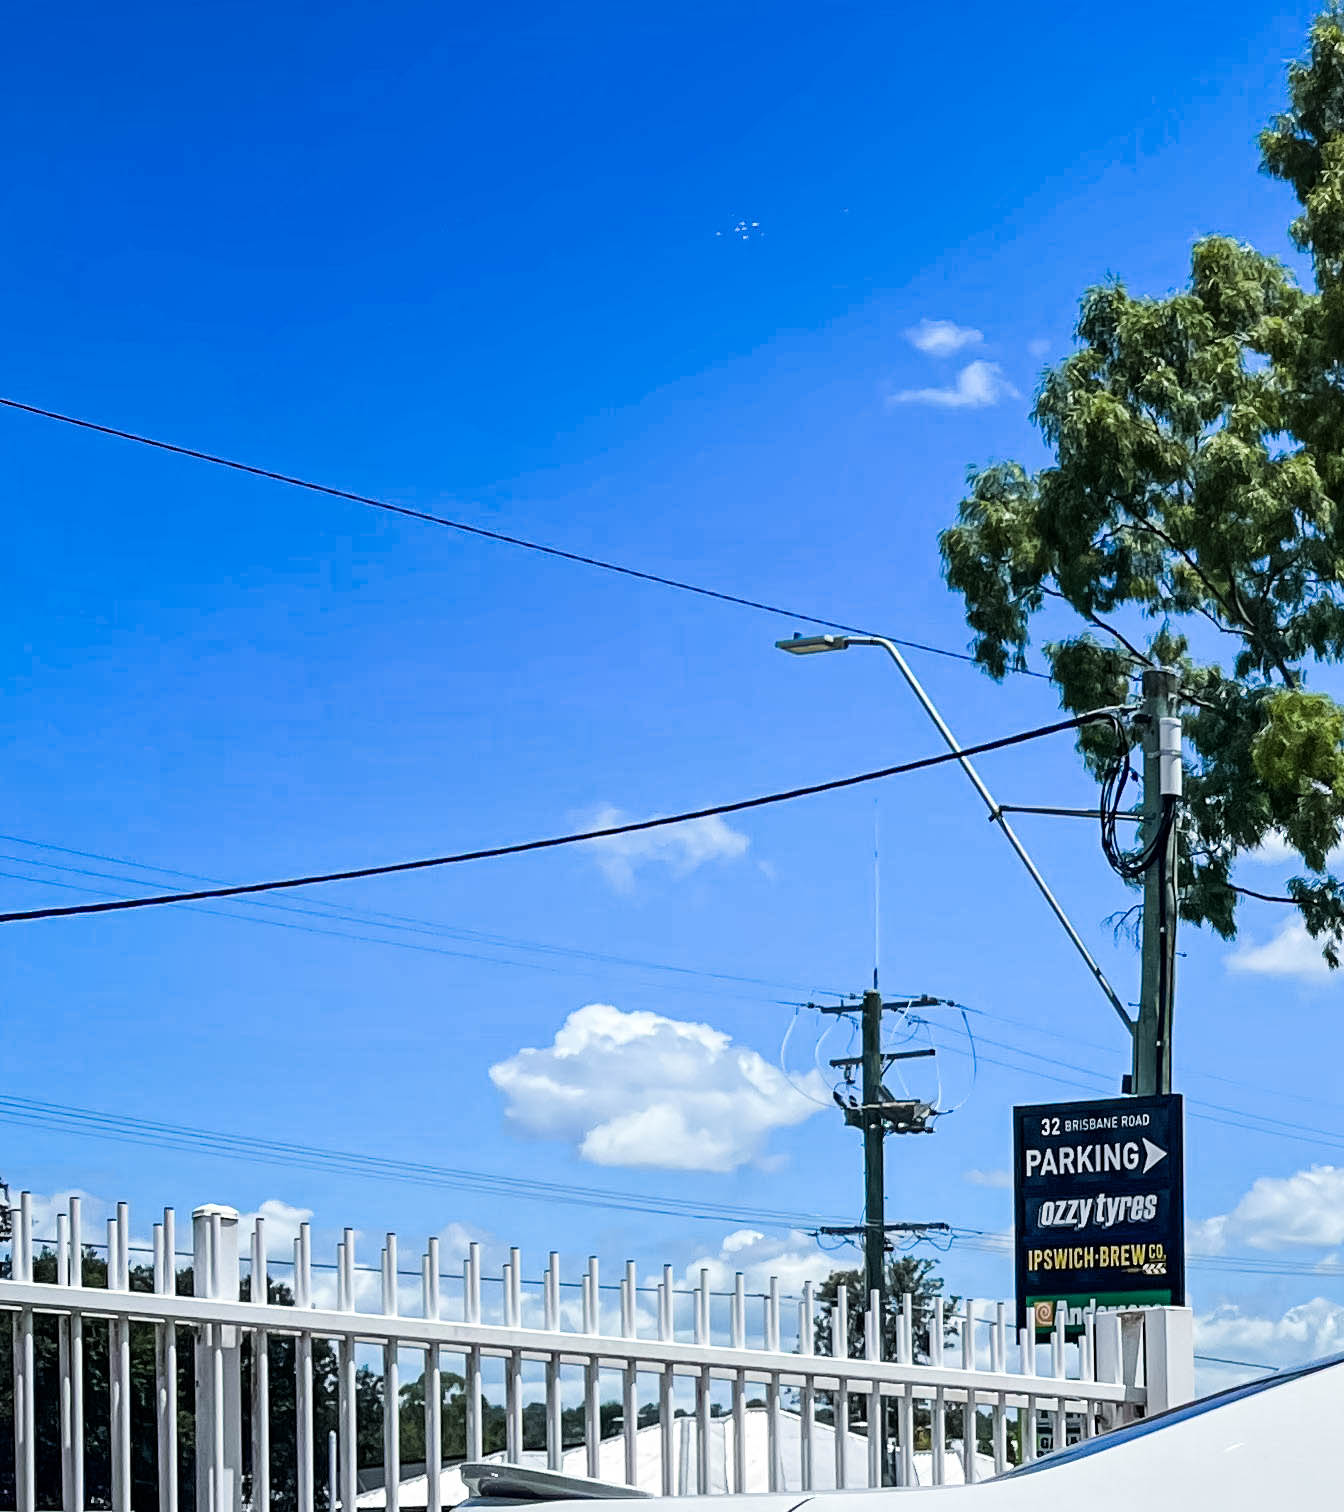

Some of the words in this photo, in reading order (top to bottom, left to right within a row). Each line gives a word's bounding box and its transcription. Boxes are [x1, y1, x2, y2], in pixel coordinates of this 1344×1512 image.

[1041, 1118, 1061, 1136] 32
[1064, 1116, 1118, 1132] BRISBANE
[1121, 1113, 1150, 1128] ROAD
[1025, 1142, 1140, 1177] PARKING
[1038, 1198, 1094, 1230] ozzy
[1094, 1193, 1158, 1229] tyres
[1028, 1246, 1094, 1271] IPSWICH
[1100, 1244, 1146, 1267] BREW
